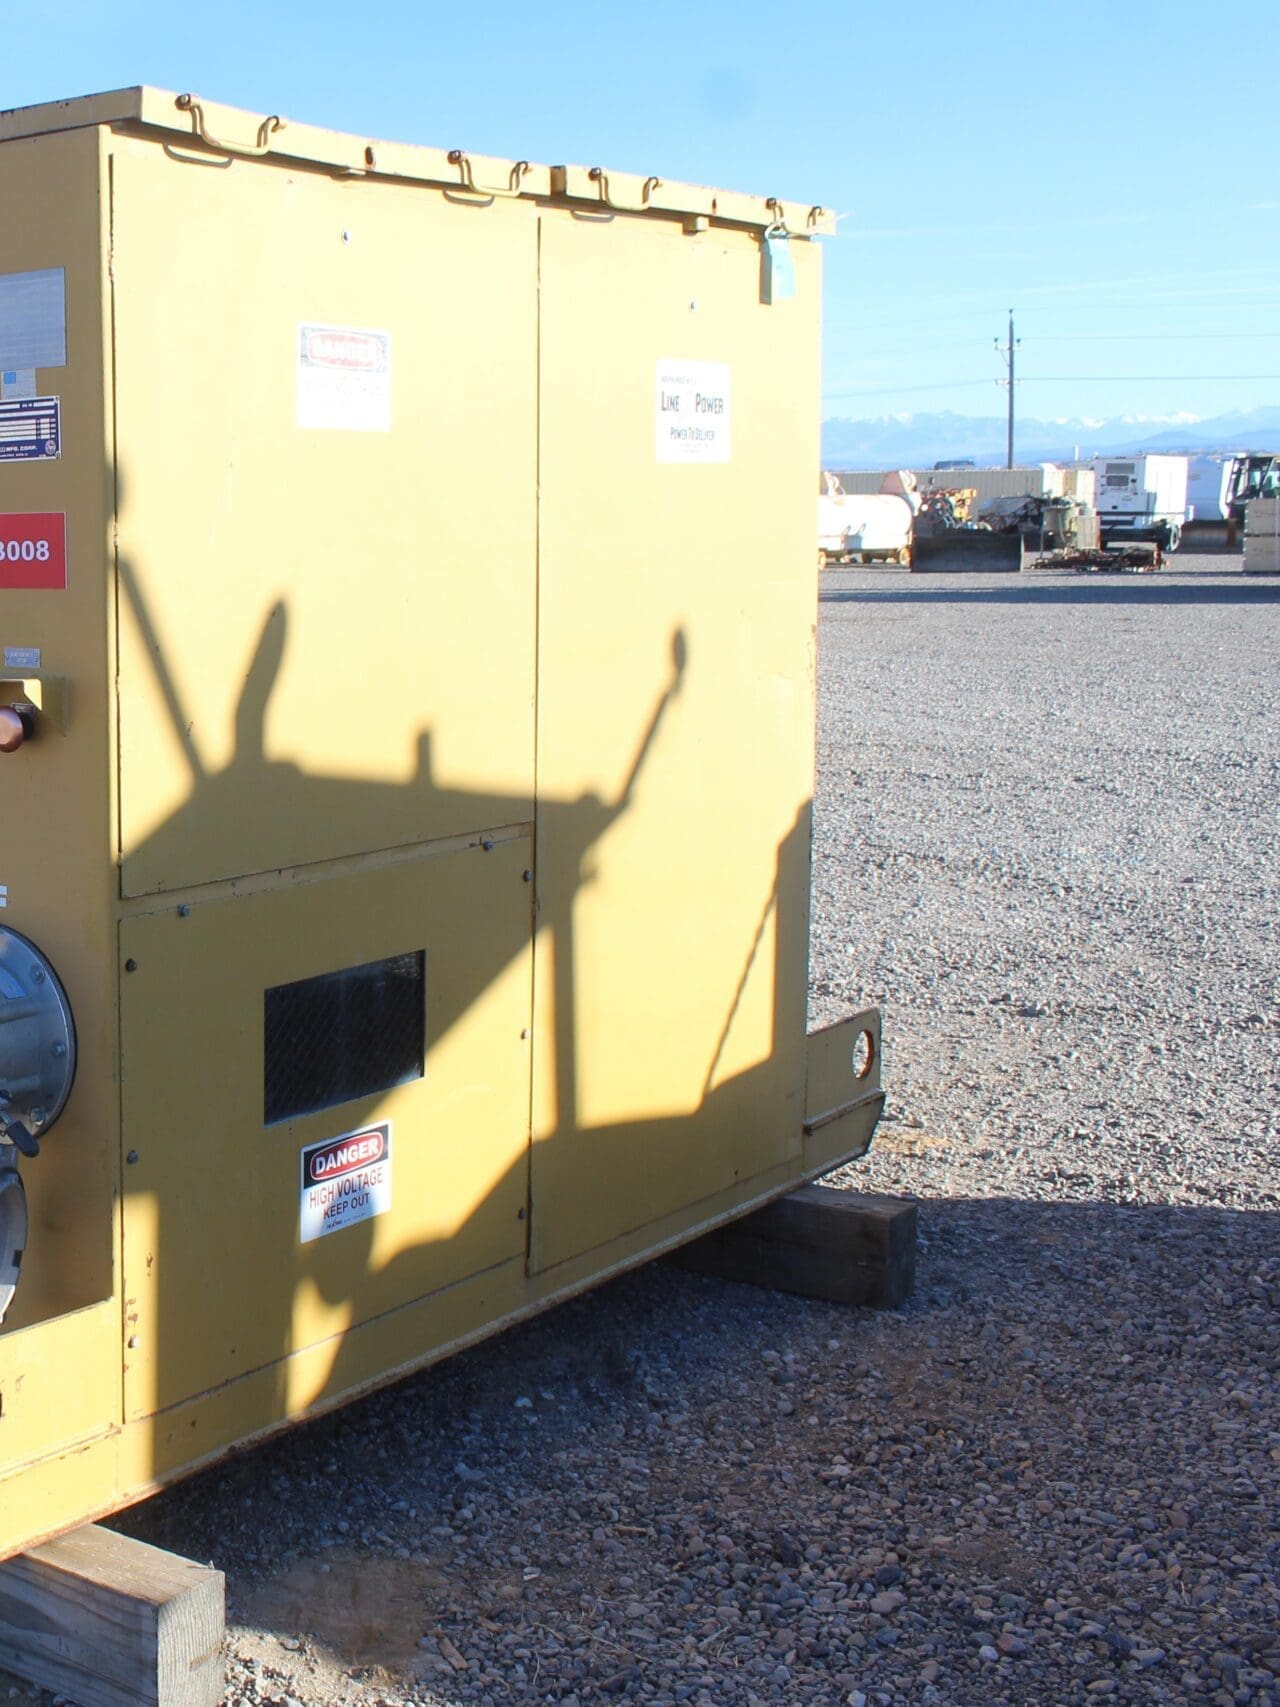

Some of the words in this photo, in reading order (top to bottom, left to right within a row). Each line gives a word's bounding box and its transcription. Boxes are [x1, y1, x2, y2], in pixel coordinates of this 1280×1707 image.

[661, 390, 680, 412] LINE
[695, 392, 724, 415] POWER
[315, 1138, 379, 1174] DANGER
[309, 1184, 335, 1208] HIGH
[337, 1166, 384, 1198] VOLTAGE
[323, 1199, 349, 1219] KEEP
[350, 1192, 371, 1209] OUT
